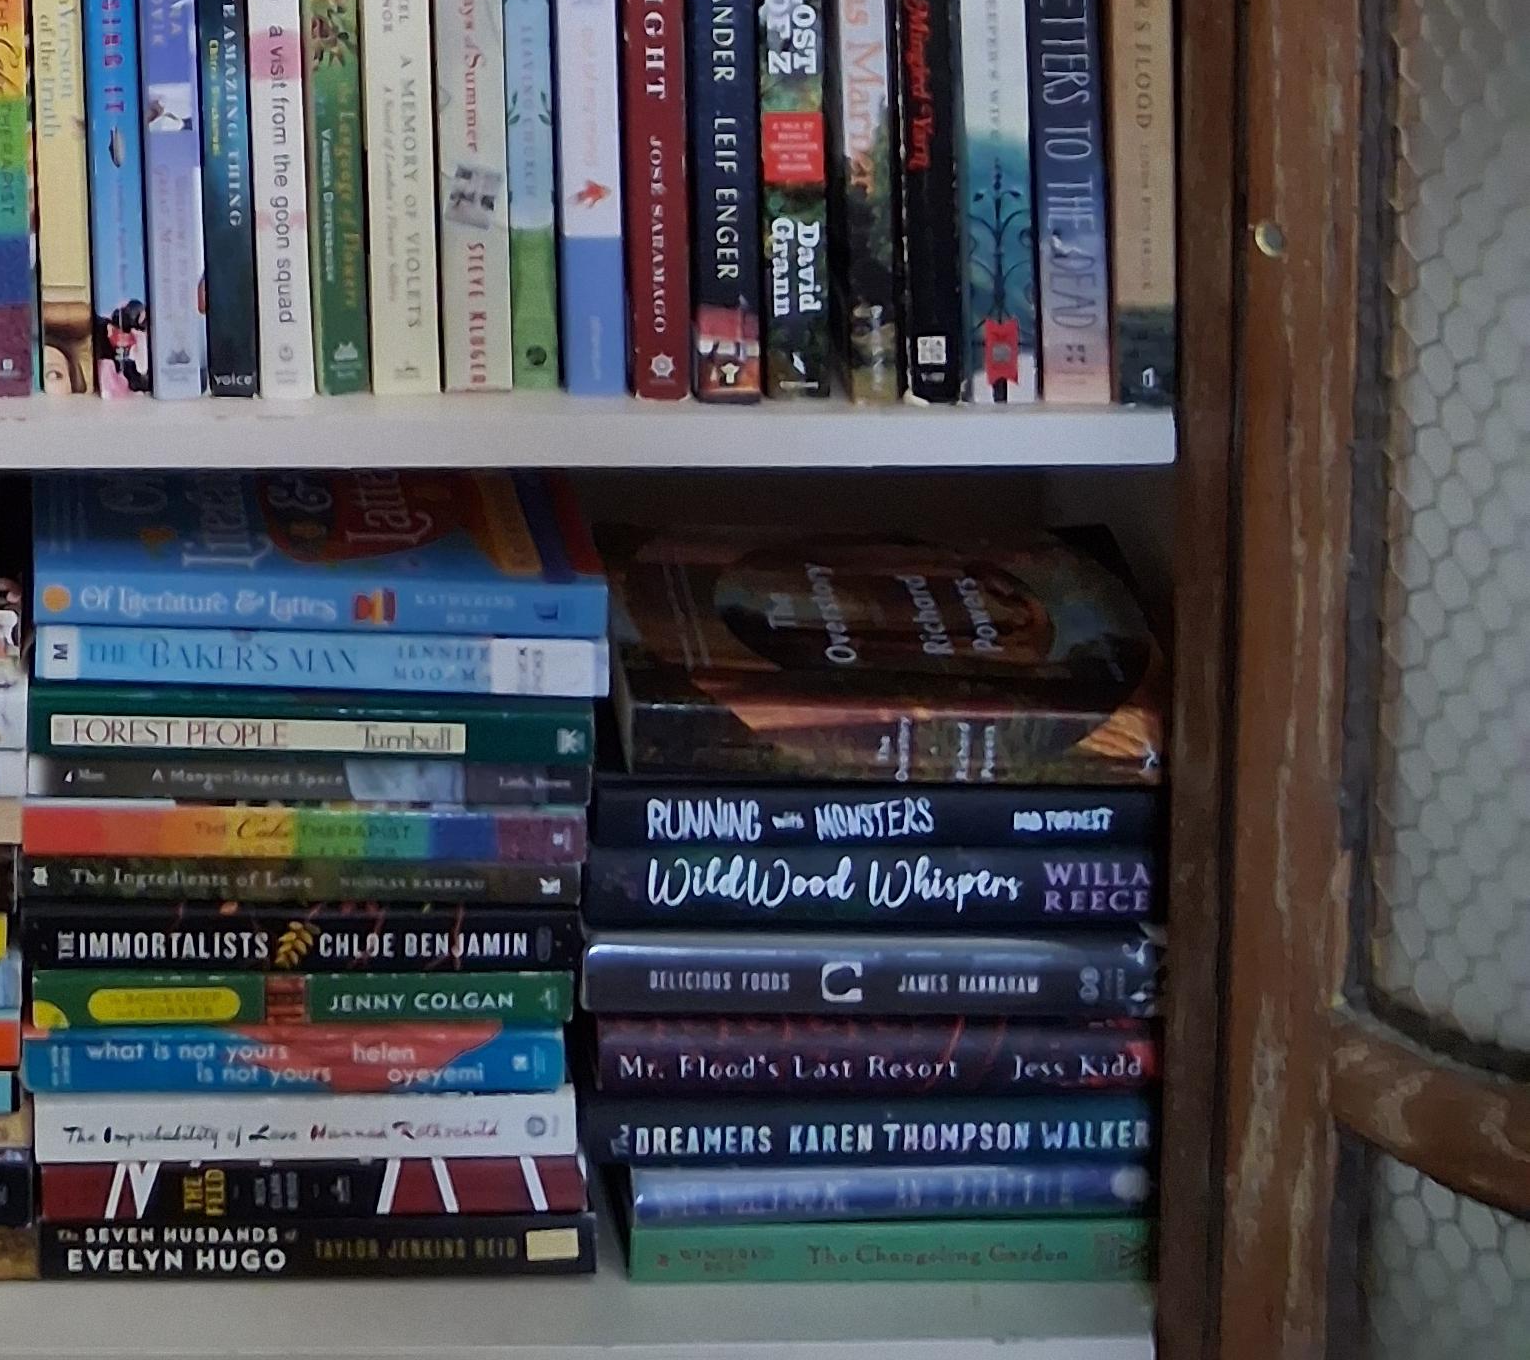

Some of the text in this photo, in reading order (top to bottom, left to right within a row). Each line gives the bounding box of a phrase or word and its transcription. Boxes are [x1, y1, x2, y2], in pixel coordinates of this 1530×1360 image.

[714, 116, 738, 280] LEIF ENGER
[772, 218, 794, 317] Grann
[797, 221, 821, 313] David
[648, 798, 762, 841] RUNNING
[815, 798, 934, 841] MONSTERS
[870, 856, 1022, 912] Whispers
[1042, 862, 1150, 884] WILLA
[1044, 891, 1149, 911] REECE
[79, 932, 527, 958] IMMORTALISTS CHLOE BENJAMIN
[329, 992, 514, 1011] JENNY COLGAN
[635, 1126, 772, 1154] DREAMERS
[790, 1122, 1150, 1152] KAREN THOMPSON WALKER
[67, 1250, 286, 1273] EVELYN HUGO
